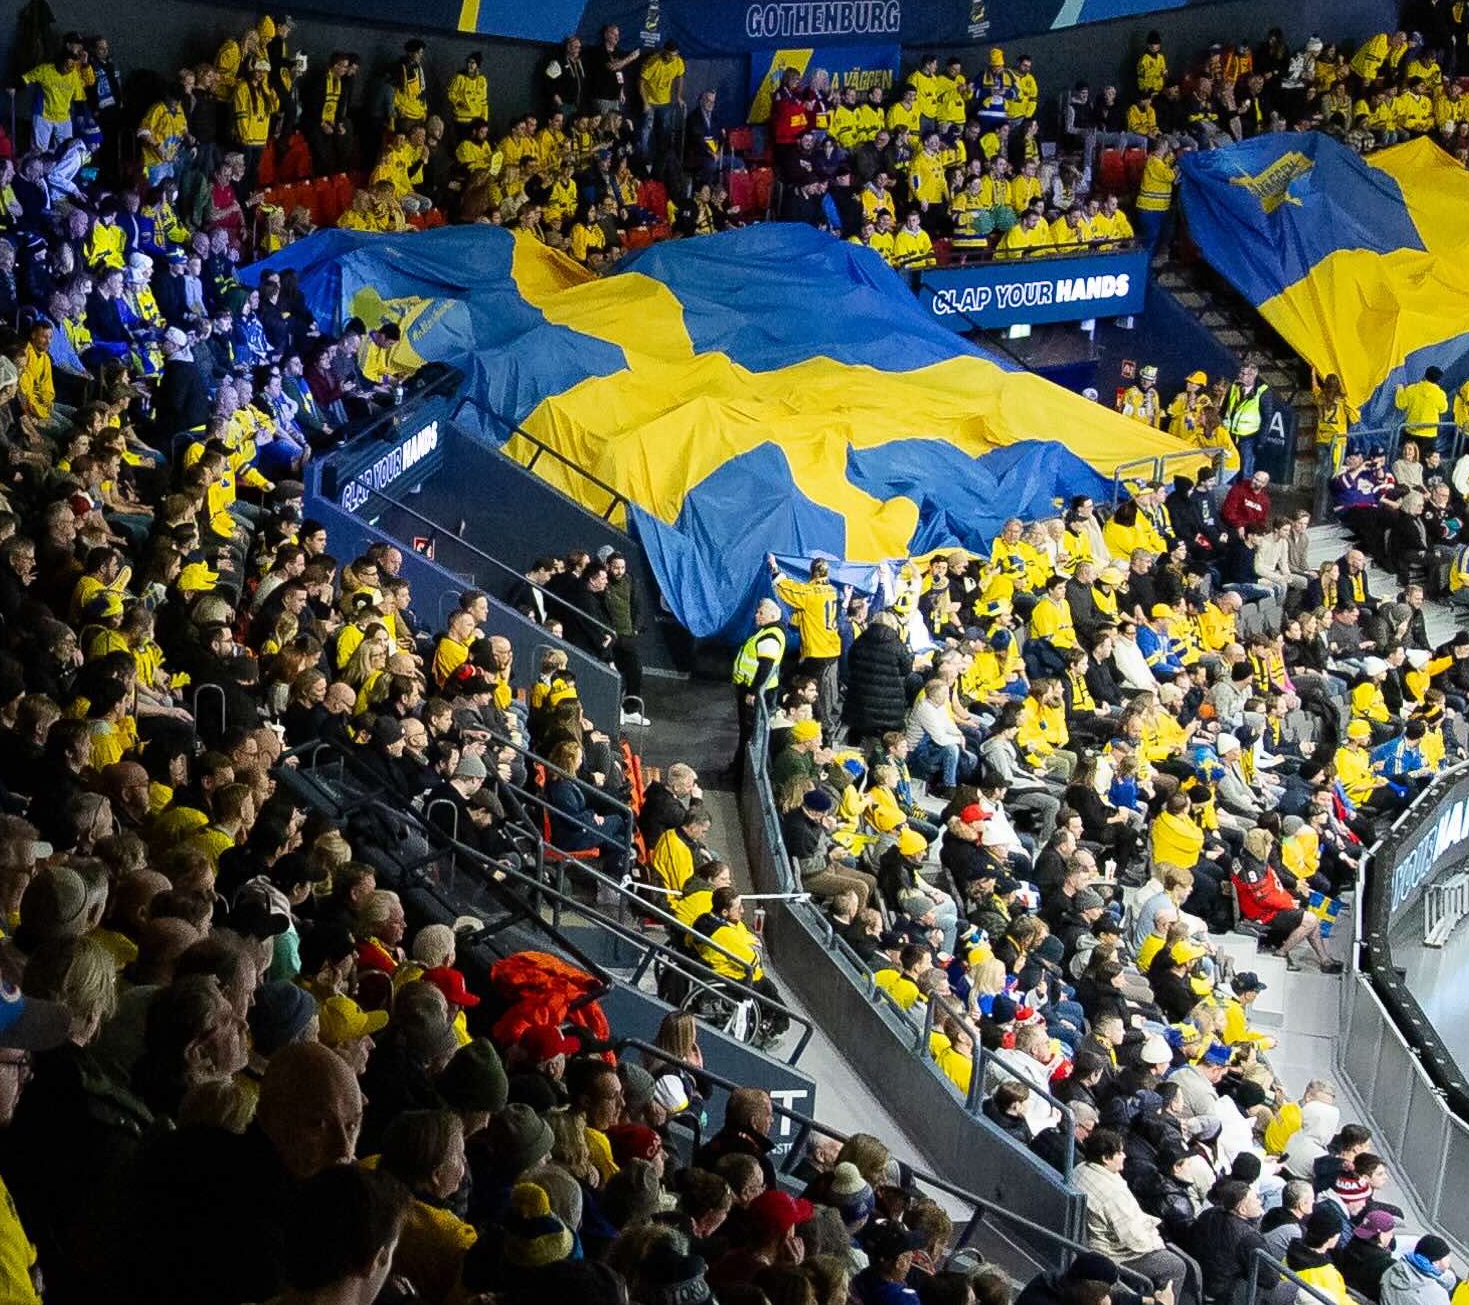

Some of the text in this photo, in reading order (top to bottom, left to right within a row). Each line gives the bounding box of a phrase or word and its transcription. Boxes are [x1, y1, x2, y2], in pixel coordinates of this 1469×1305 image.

[745, 0, 903, 38] GOTHENBURG
[932, 272, 1130, 317] CLAP YOUR HANDS
[1268, 411, 1285, 438] A
[373, 446, 403, 492] YOUR
[402, 420, 439, 472] HANDS
[769, 1088, 808, 1137] T
